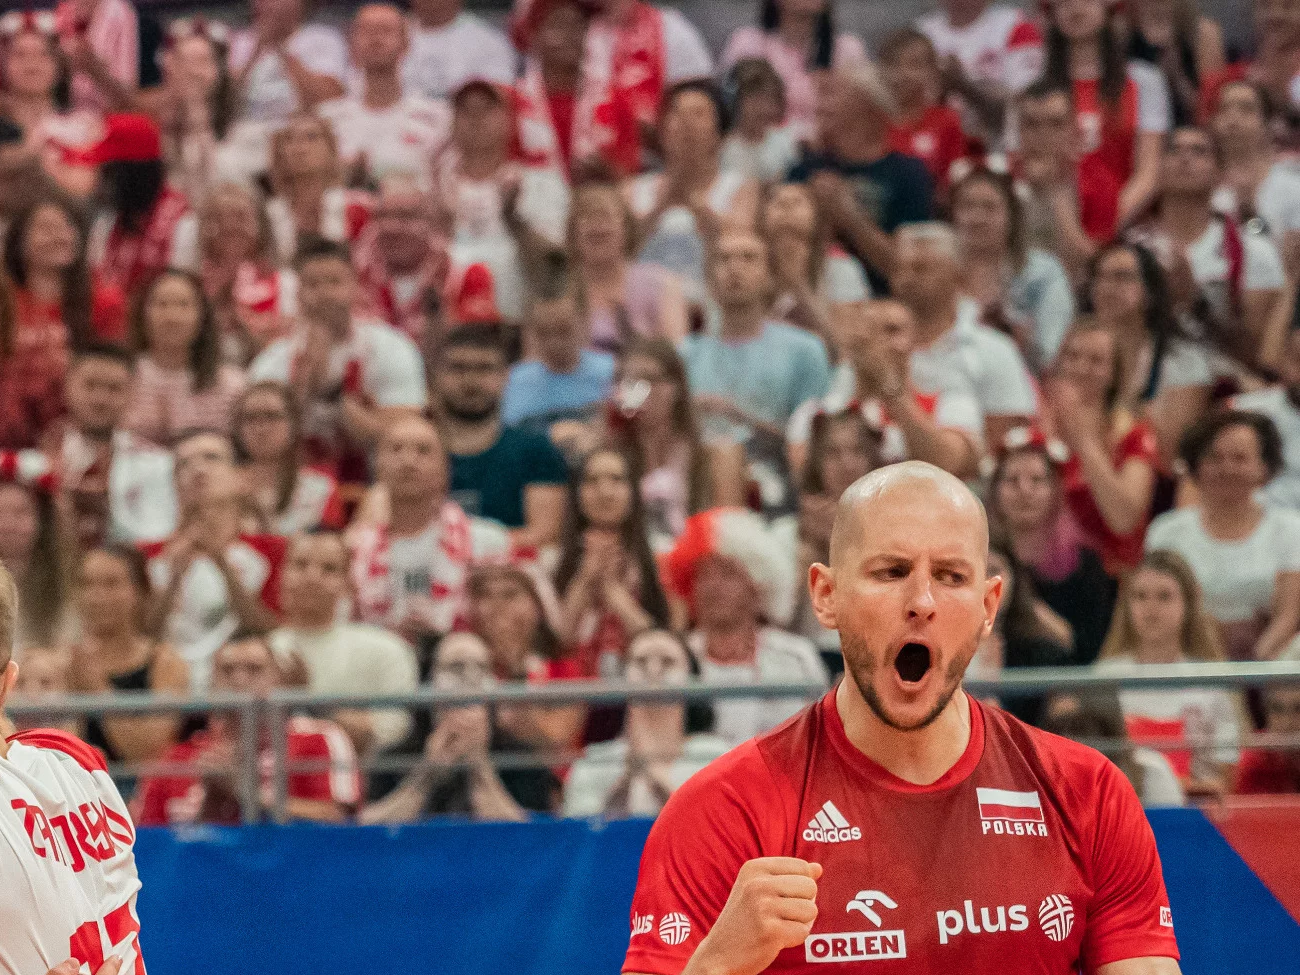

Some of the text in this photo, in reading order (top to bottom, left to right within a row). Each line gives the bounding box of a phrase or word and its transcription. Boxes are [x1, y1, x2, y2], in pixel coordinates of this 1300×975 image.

[802, 826, 862, 844] adidas
[981, 820, 1049, 837] POLSKA
[936, 899, 1030, 945] plus
[809, 934, 901, 959] ORLEN
